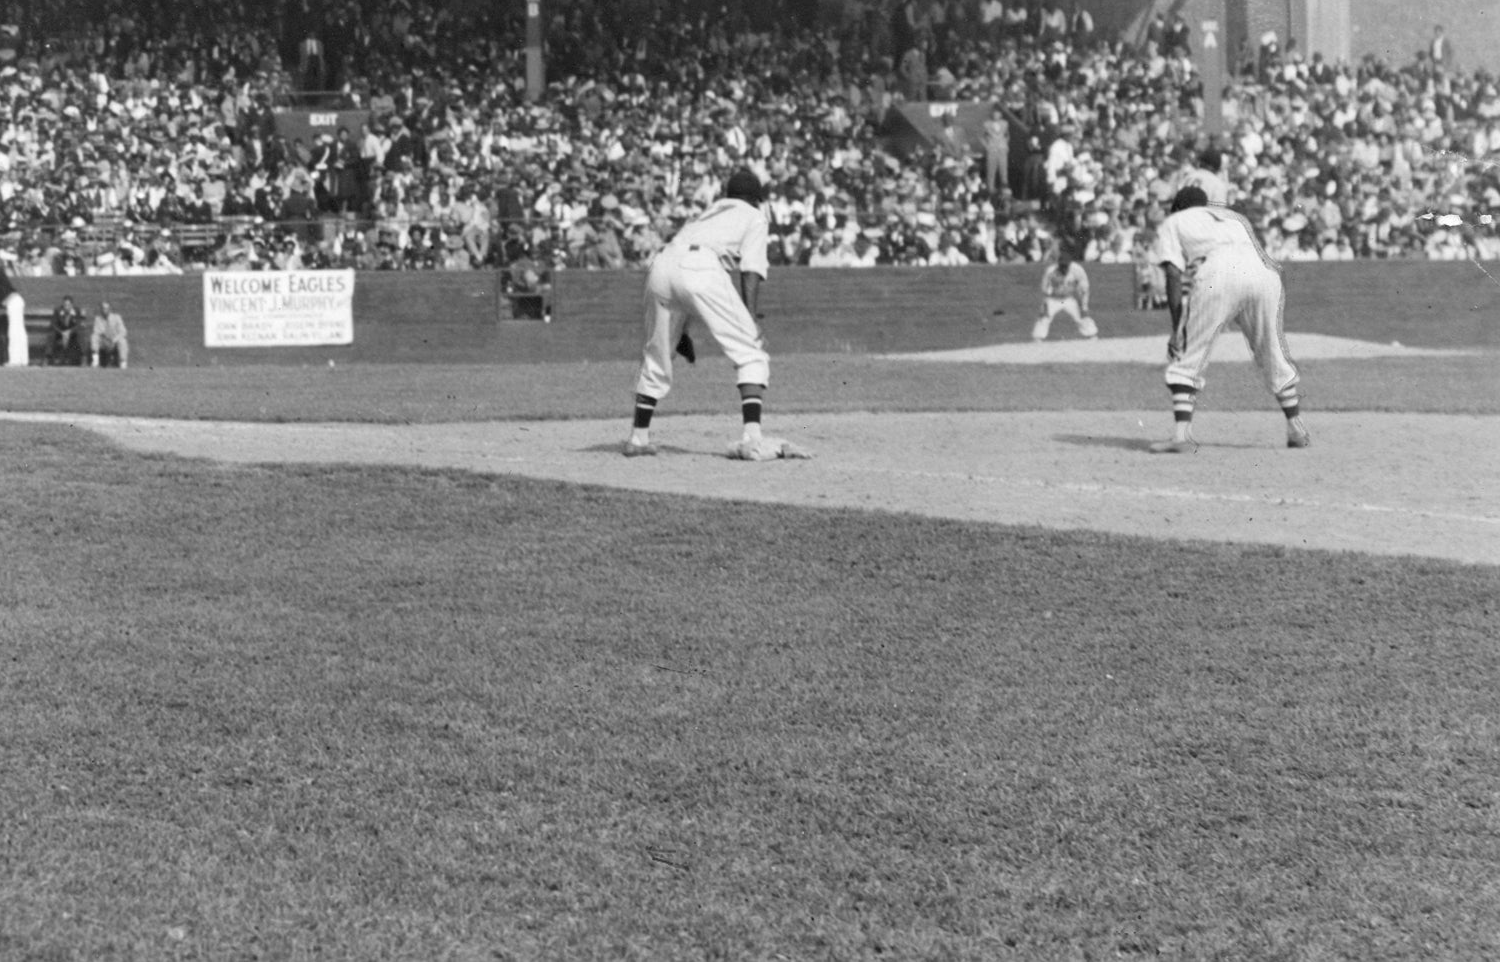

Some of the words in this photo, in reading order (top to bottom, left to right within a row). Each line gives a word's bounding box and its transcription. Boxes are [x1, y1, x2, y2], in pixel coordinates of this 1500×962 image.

[1203, 32, 1218, 48] A
[310, 112, 337, 126] EXIT
[211, 276, 282, 294] WELCOME
[288, 274, 346, 293] EAGLES
[210, 296, 266, 312] VINCENT
